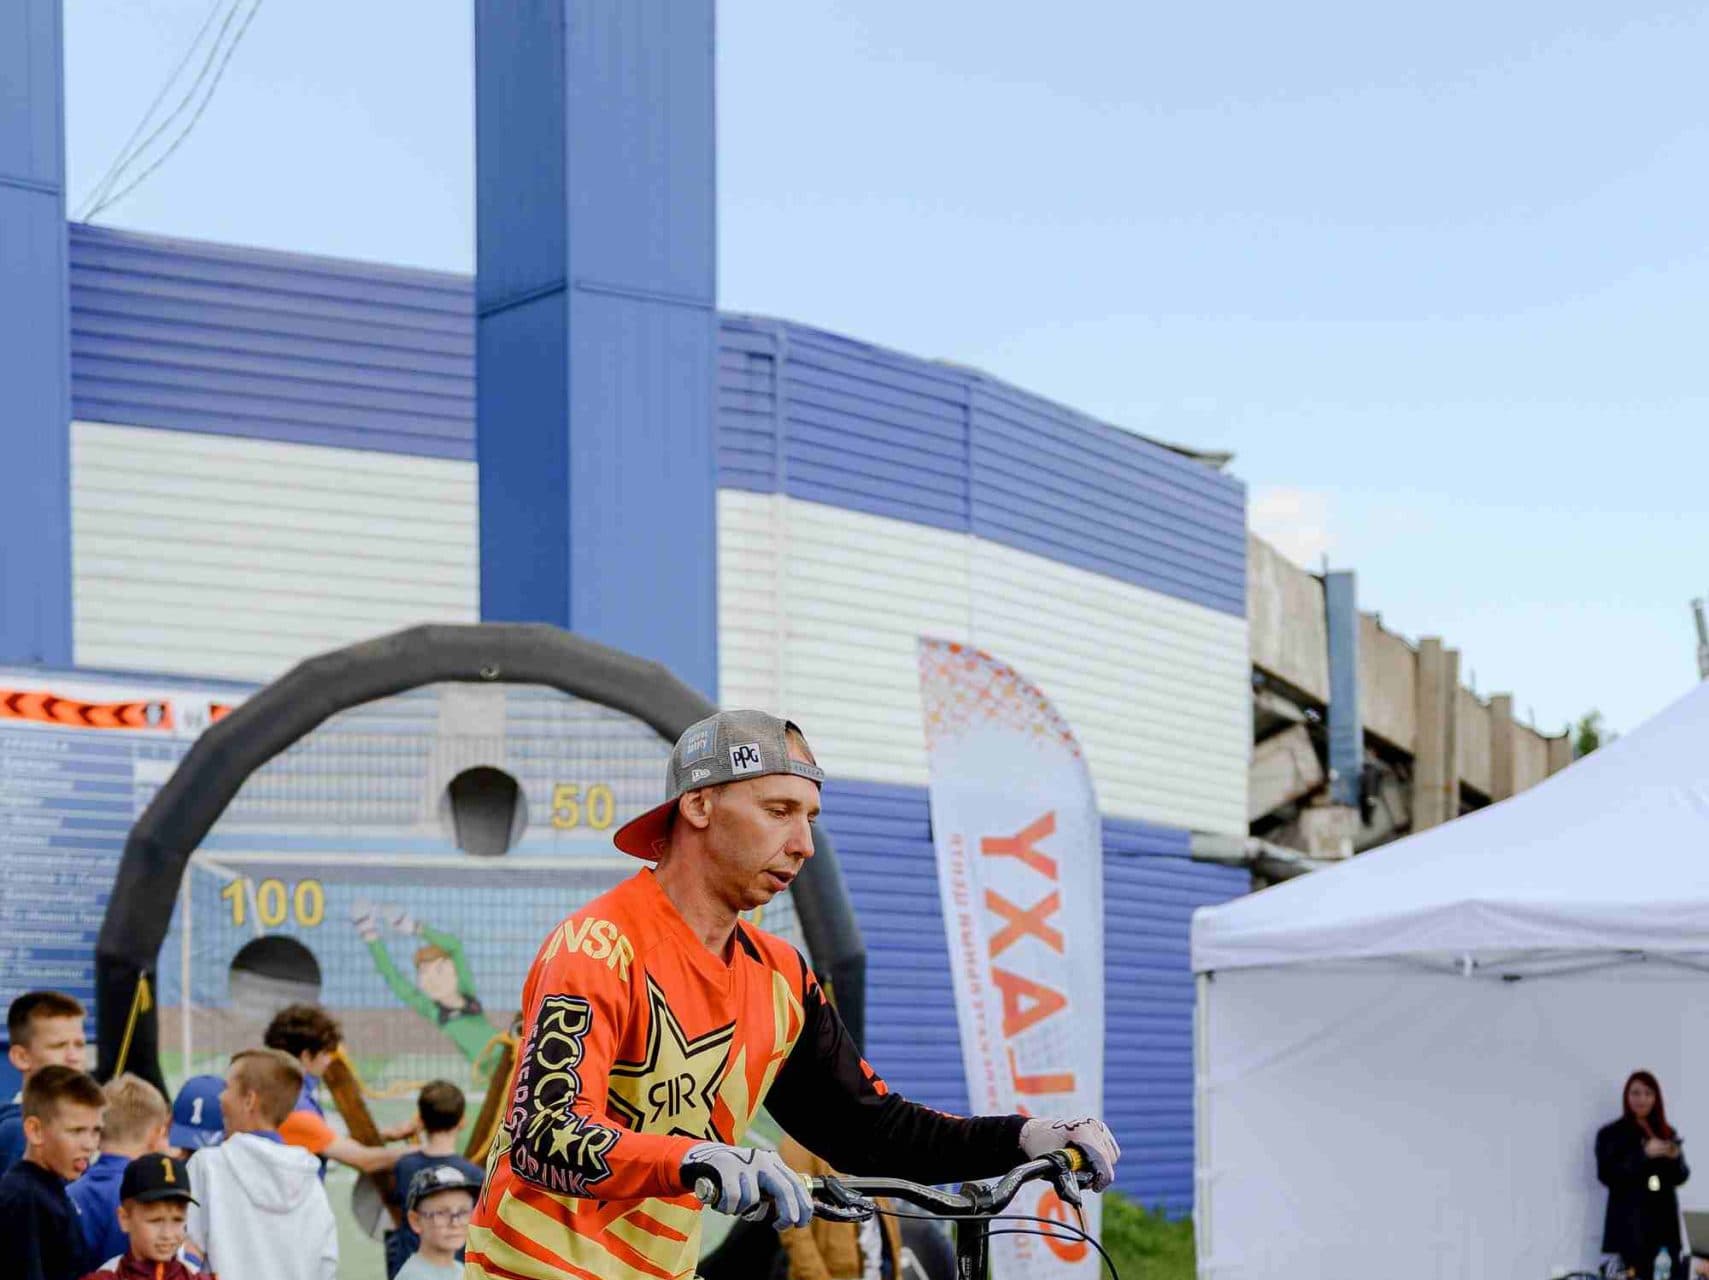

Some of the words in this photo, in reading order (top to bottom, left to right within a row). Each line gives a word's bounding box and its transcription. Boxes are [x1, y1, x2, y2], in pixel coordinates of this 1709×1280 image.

[733, 745, 759, 769] PPG
[552, 784, 616, 829] 50
[221, 880, 324, 927] 100
[191, 1097, 204, 1124] 1
[161, 1158, 176, 1183] 1
